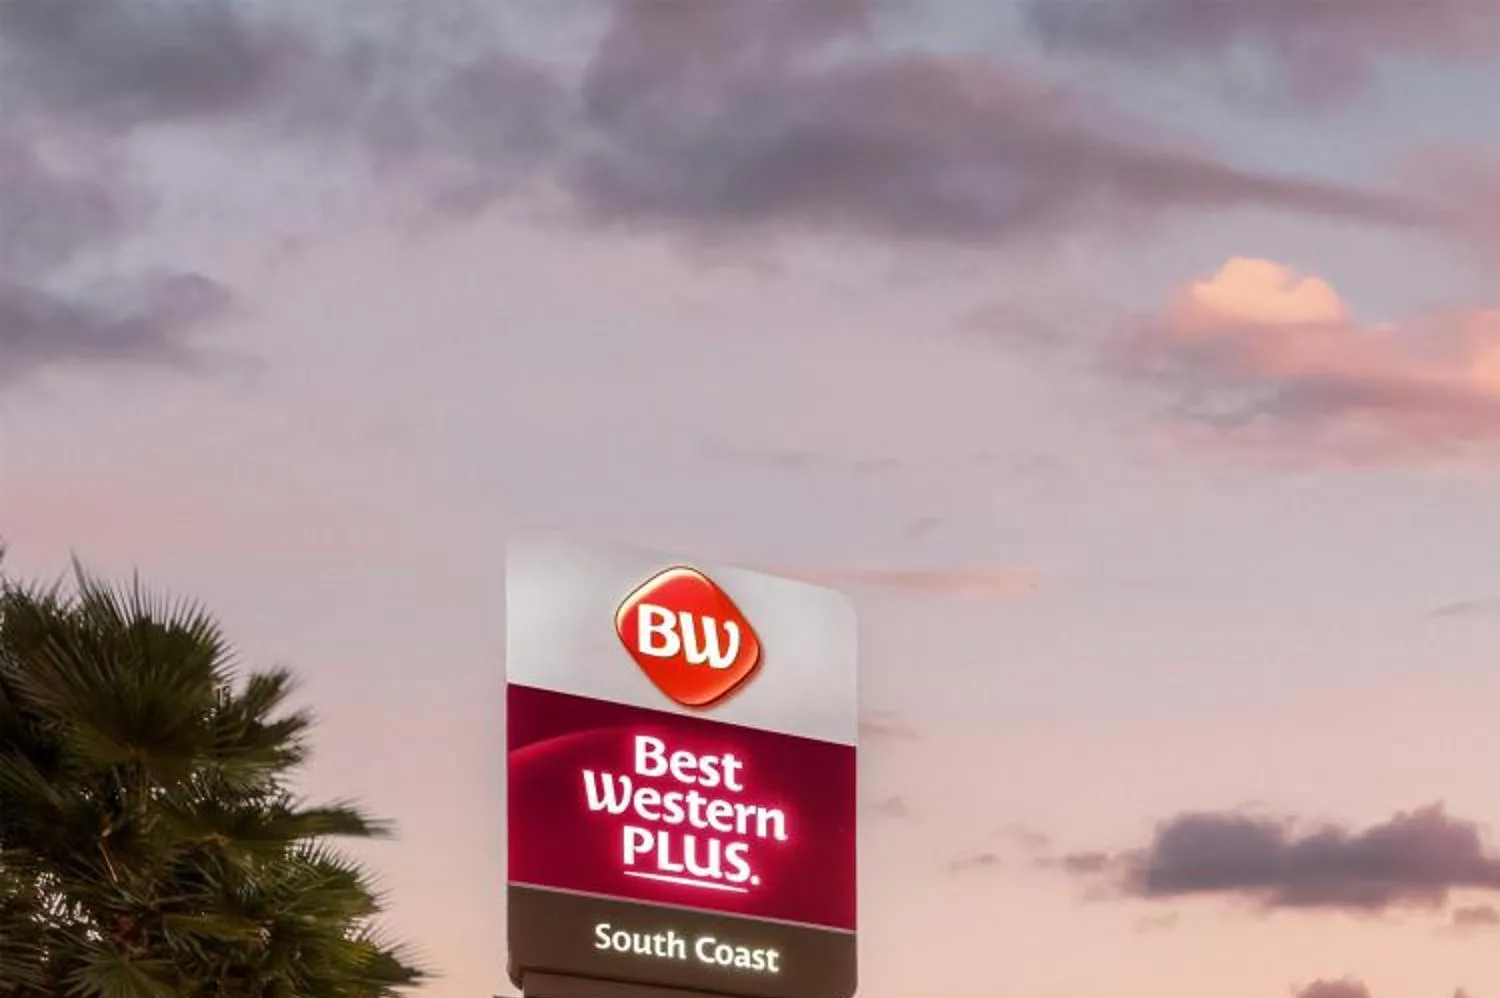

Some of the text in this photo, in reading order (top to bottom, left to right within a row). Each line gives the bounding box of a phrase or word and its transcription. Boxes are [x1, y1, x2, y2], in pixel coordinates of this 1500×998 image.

[637, 603, 740, 669] BW
[634, 736, 743, 791] Best
[583, 769, 787, 841] Western
[594, 923, 780, 974] South Coast
